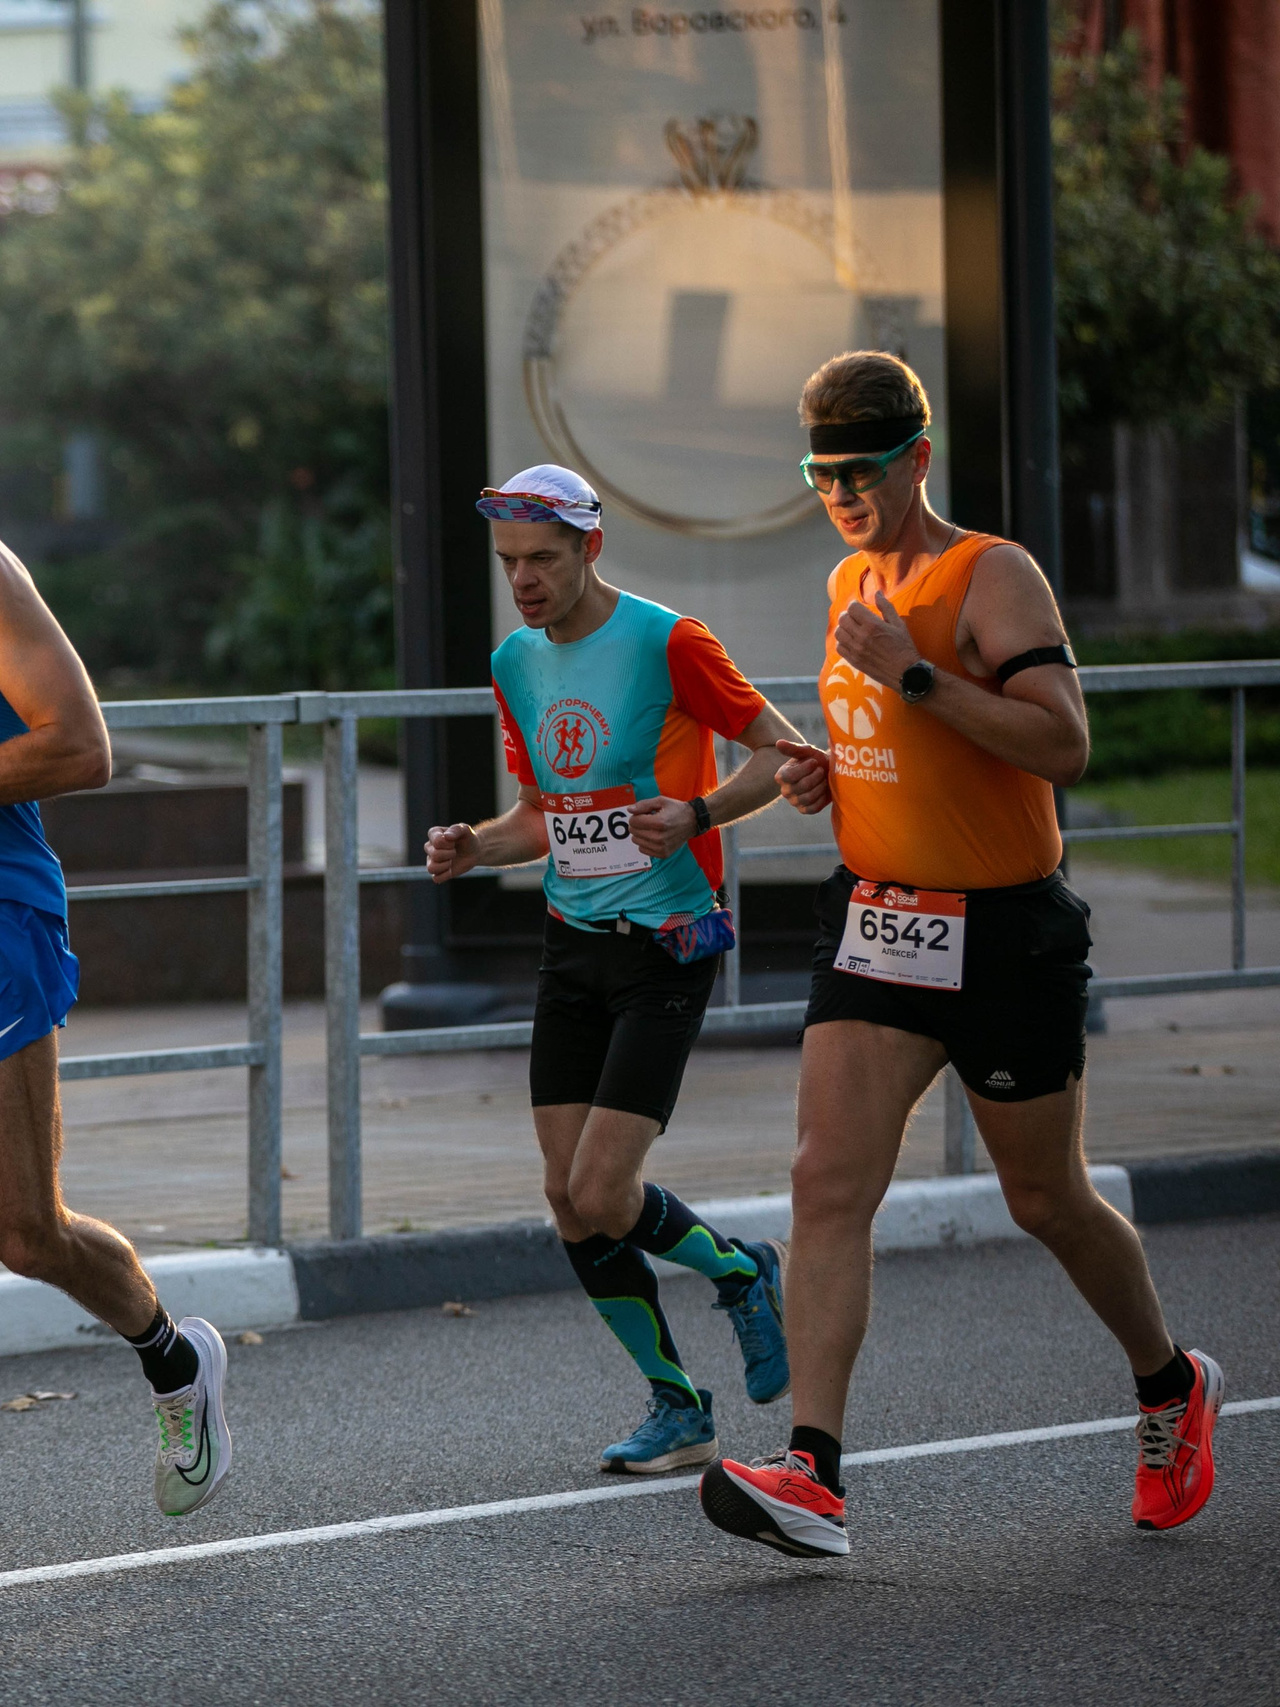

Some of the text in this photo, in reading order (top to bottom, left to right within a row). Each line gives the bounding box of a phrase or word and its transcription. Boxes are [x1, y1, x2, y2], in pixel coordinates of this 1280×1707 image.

[545, 703, 558, 719] ПО
[559, 698, 612, 737] ГОРЯЧЕМУ
[835, 743, 896, 769] SOCHI
[834, 762, 899, 784] MARATHON
[552, 811, 630, 845] 6426
[572, 844, 608, 855] НИКОЛАЙ
[860, 909, 949, 952] 6542
[881, 947, 918, 960] АЛЕКСЕЙ
